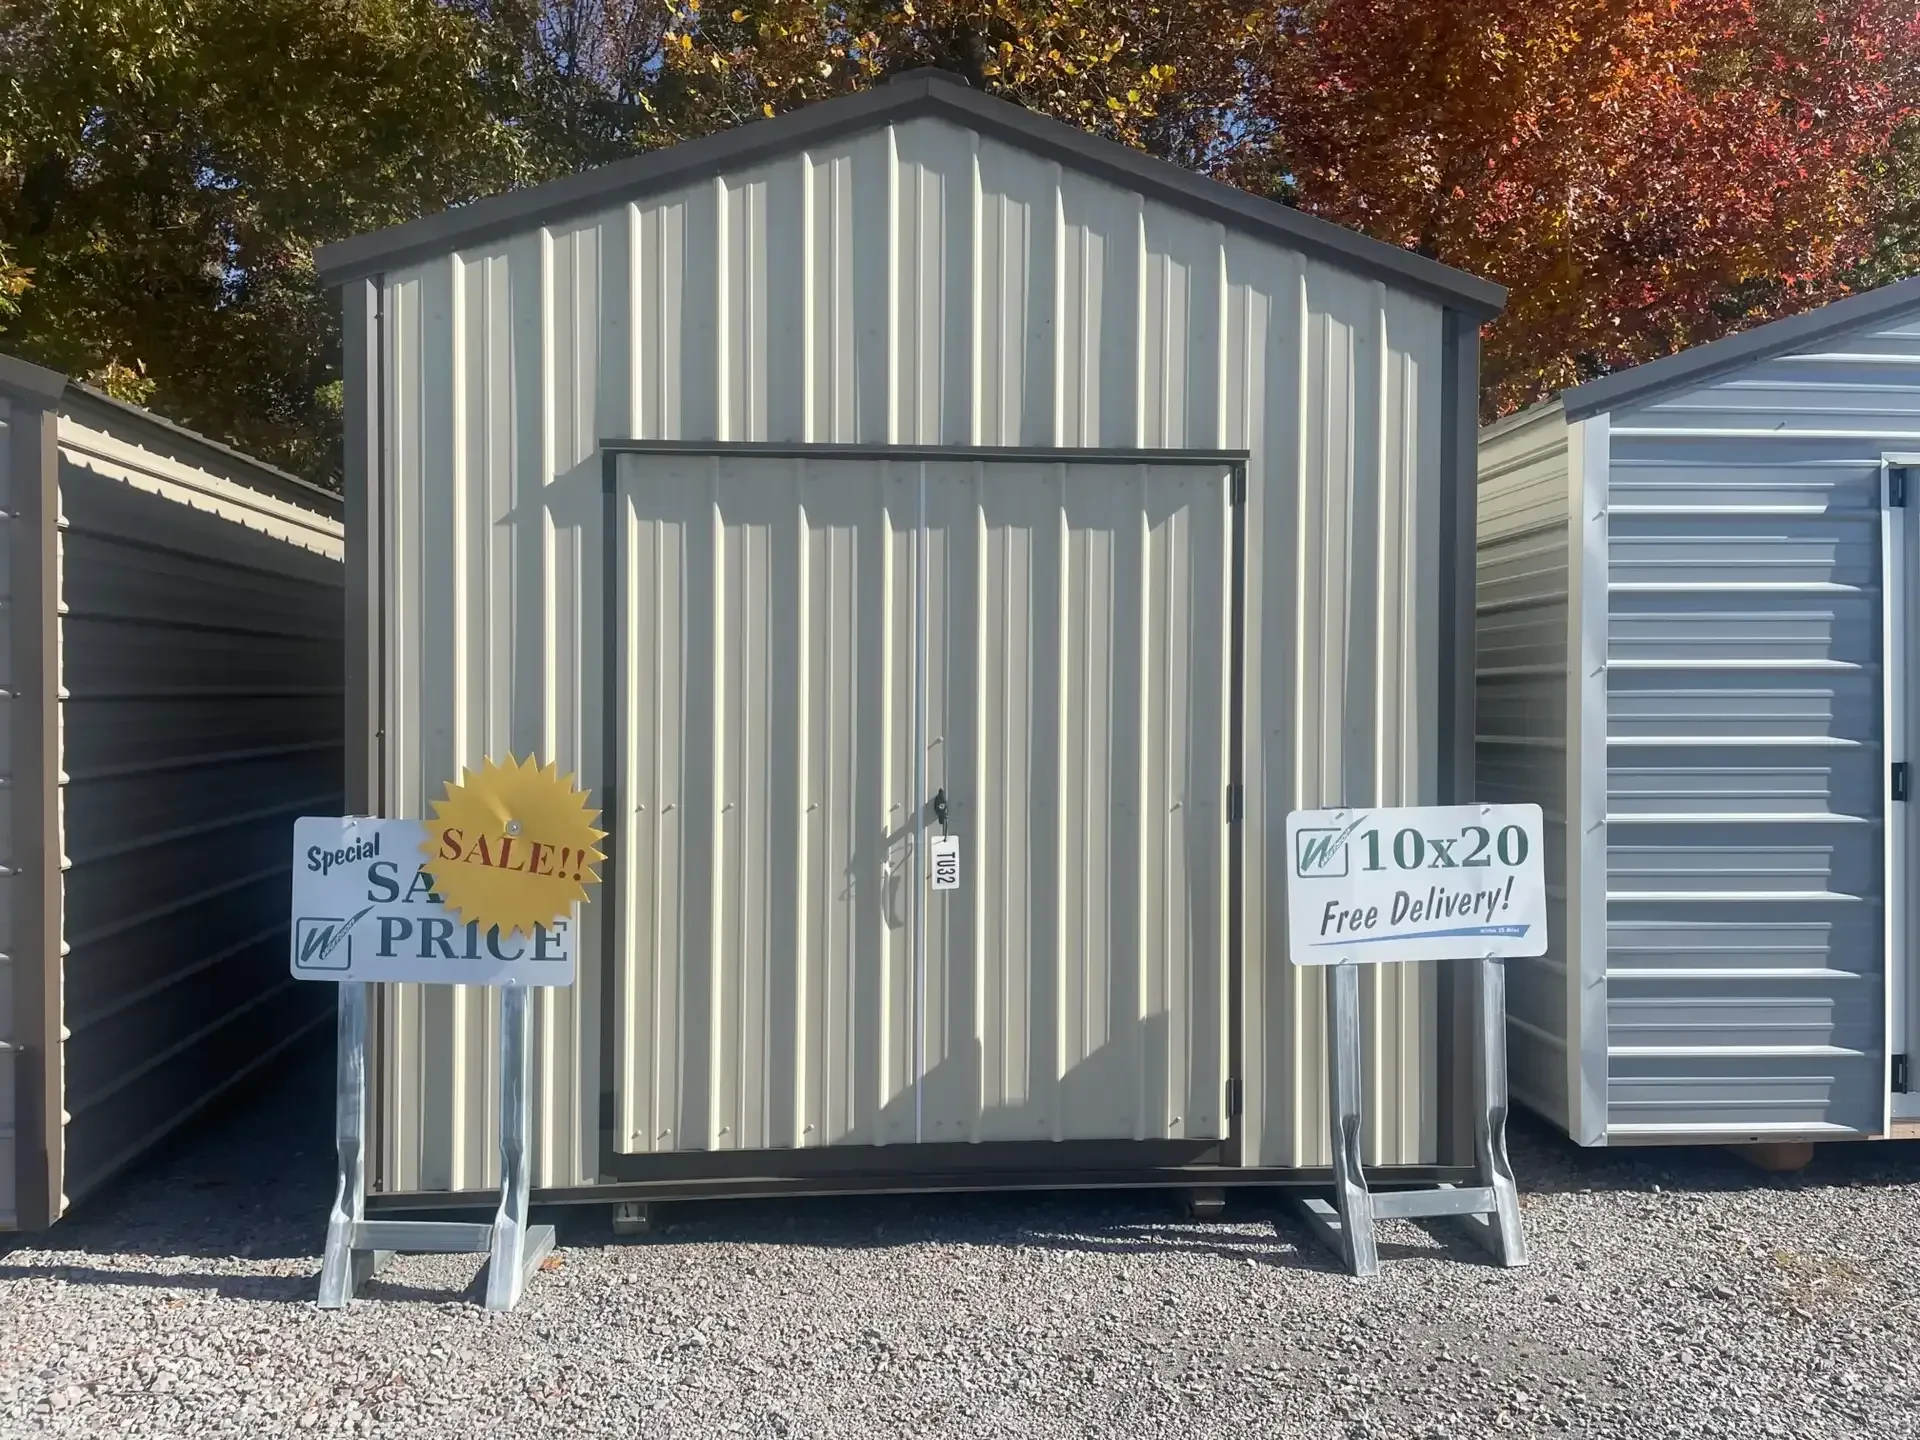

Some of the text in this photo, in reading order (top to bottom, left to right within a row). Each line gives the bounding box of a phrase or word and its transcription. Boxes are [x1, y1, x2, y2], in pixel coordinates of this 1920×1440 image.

[307, 832, 380, 876] Special
[438, 828, 586, 881] SALE!!
[936, 851, 956, 884] TU32
[1360, 825, 1529, 871] 10x20
[367, 861, 445, 904] SA
[1320, 875, 1515, 936] Free Delivery!
[375, 915, 568, 962] PRICE
